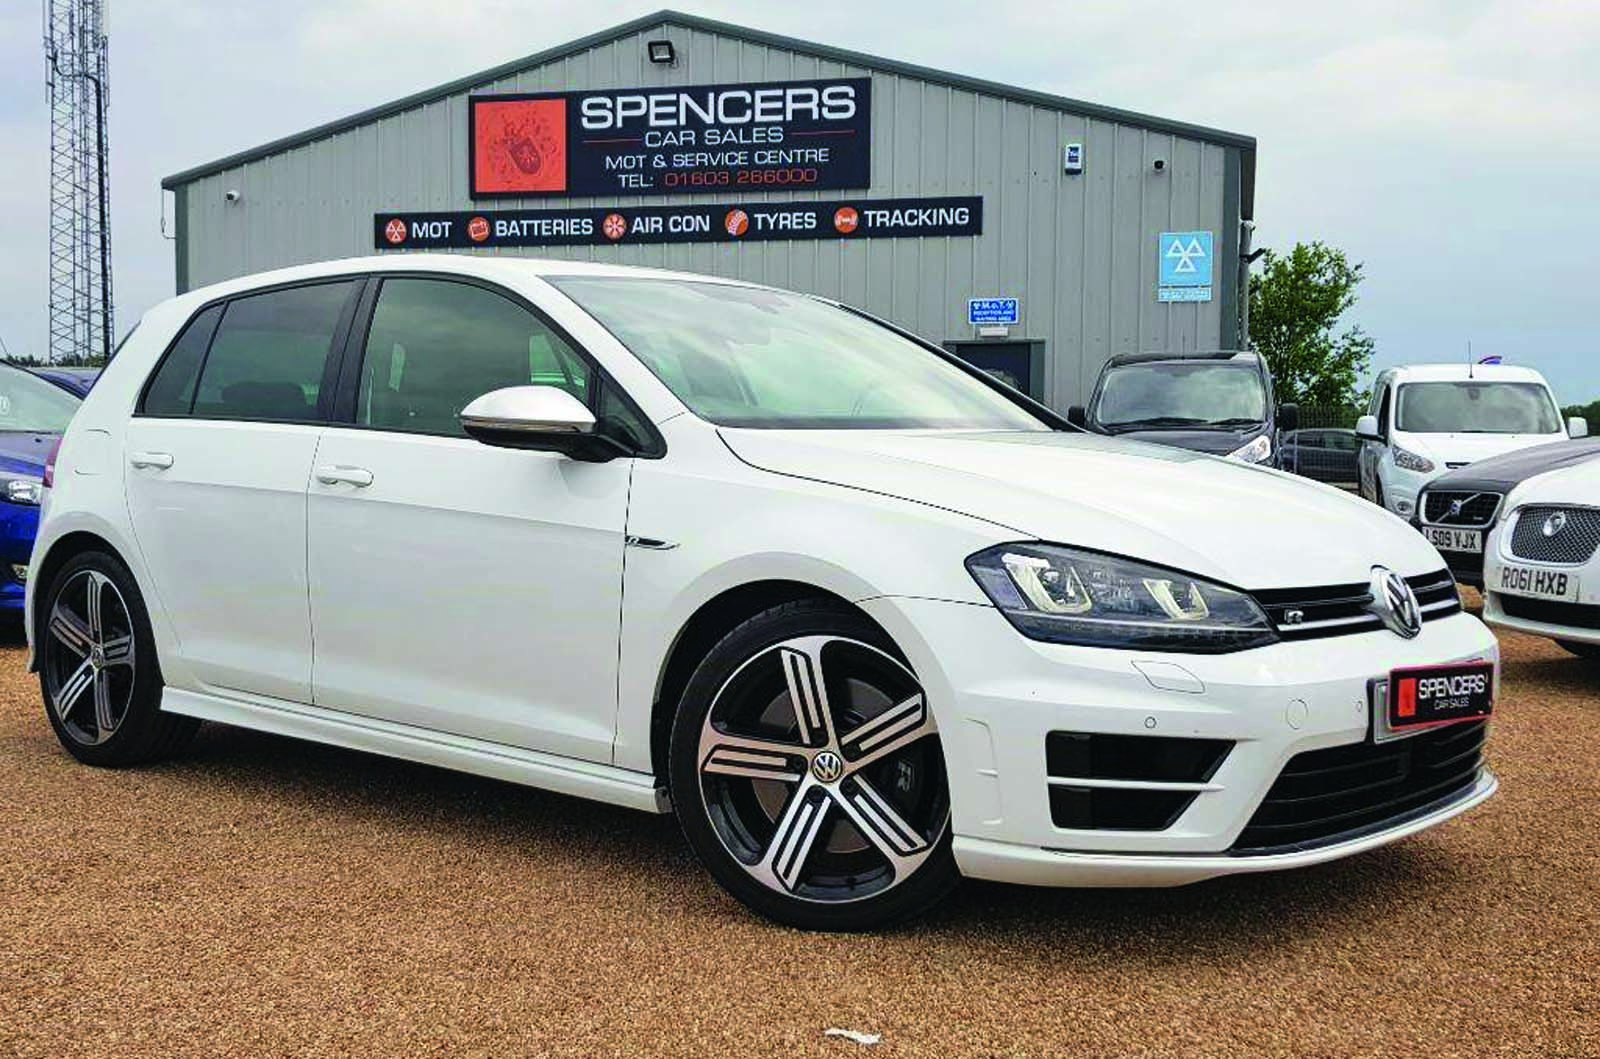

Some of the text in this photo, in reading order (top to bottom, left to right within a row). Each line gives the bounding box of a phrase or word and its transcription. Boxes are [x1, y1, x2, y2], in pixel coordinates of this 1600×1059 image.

[580, 85, 856, 130] SPENCERS
[645, 127, 784, 148] CAR SALES
[605, 148, 830, 170] MOT & SERVICE CENTRE
[618, 173, 653, 188] TEL:
[664, 170, 730, 187] 01603
[495, 218, 594, 237] BATTERIES
[632, 214, 710, 234] AIR CON
[754, 211, 817, 230] TYRES
[864, 207, 970, 228] TRACKING
[412, 222, 453, 238] MOT
[1455, 532, 1477, 550] VJX
[1501, 566, 1569, 596] RO61 HXB
[1418, 673, 1486, 700] SPENCERS
[1433, 696, 1470, 710] CAR SALES
